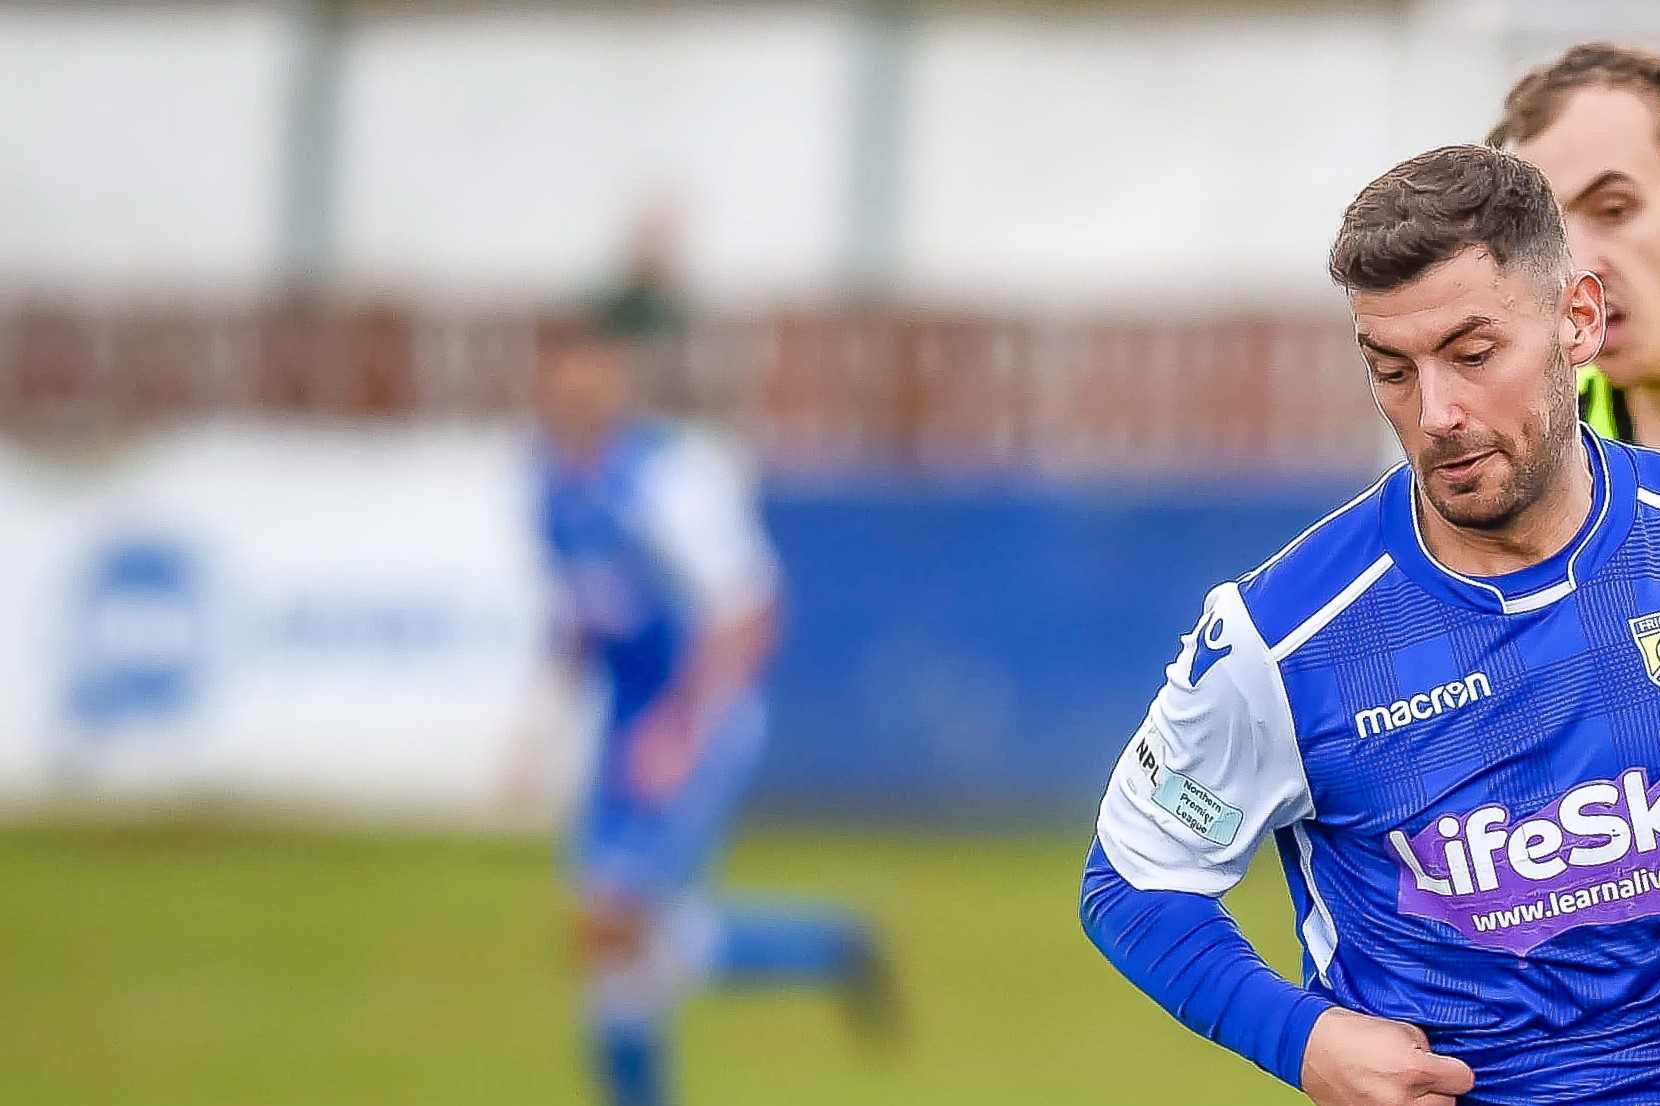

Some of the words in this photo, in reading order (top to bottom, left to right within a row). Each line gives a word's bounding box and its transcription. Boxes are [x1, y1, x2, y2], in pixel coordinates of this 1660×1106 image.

[1354, 671, 1492, 739] macron
[1136, 737, 1160, 787] NPL
[1179, 792, 1214, 824] Premier
[1183, 780, 1222, 813] Northern
[1176, 805, 1208, 834] League
